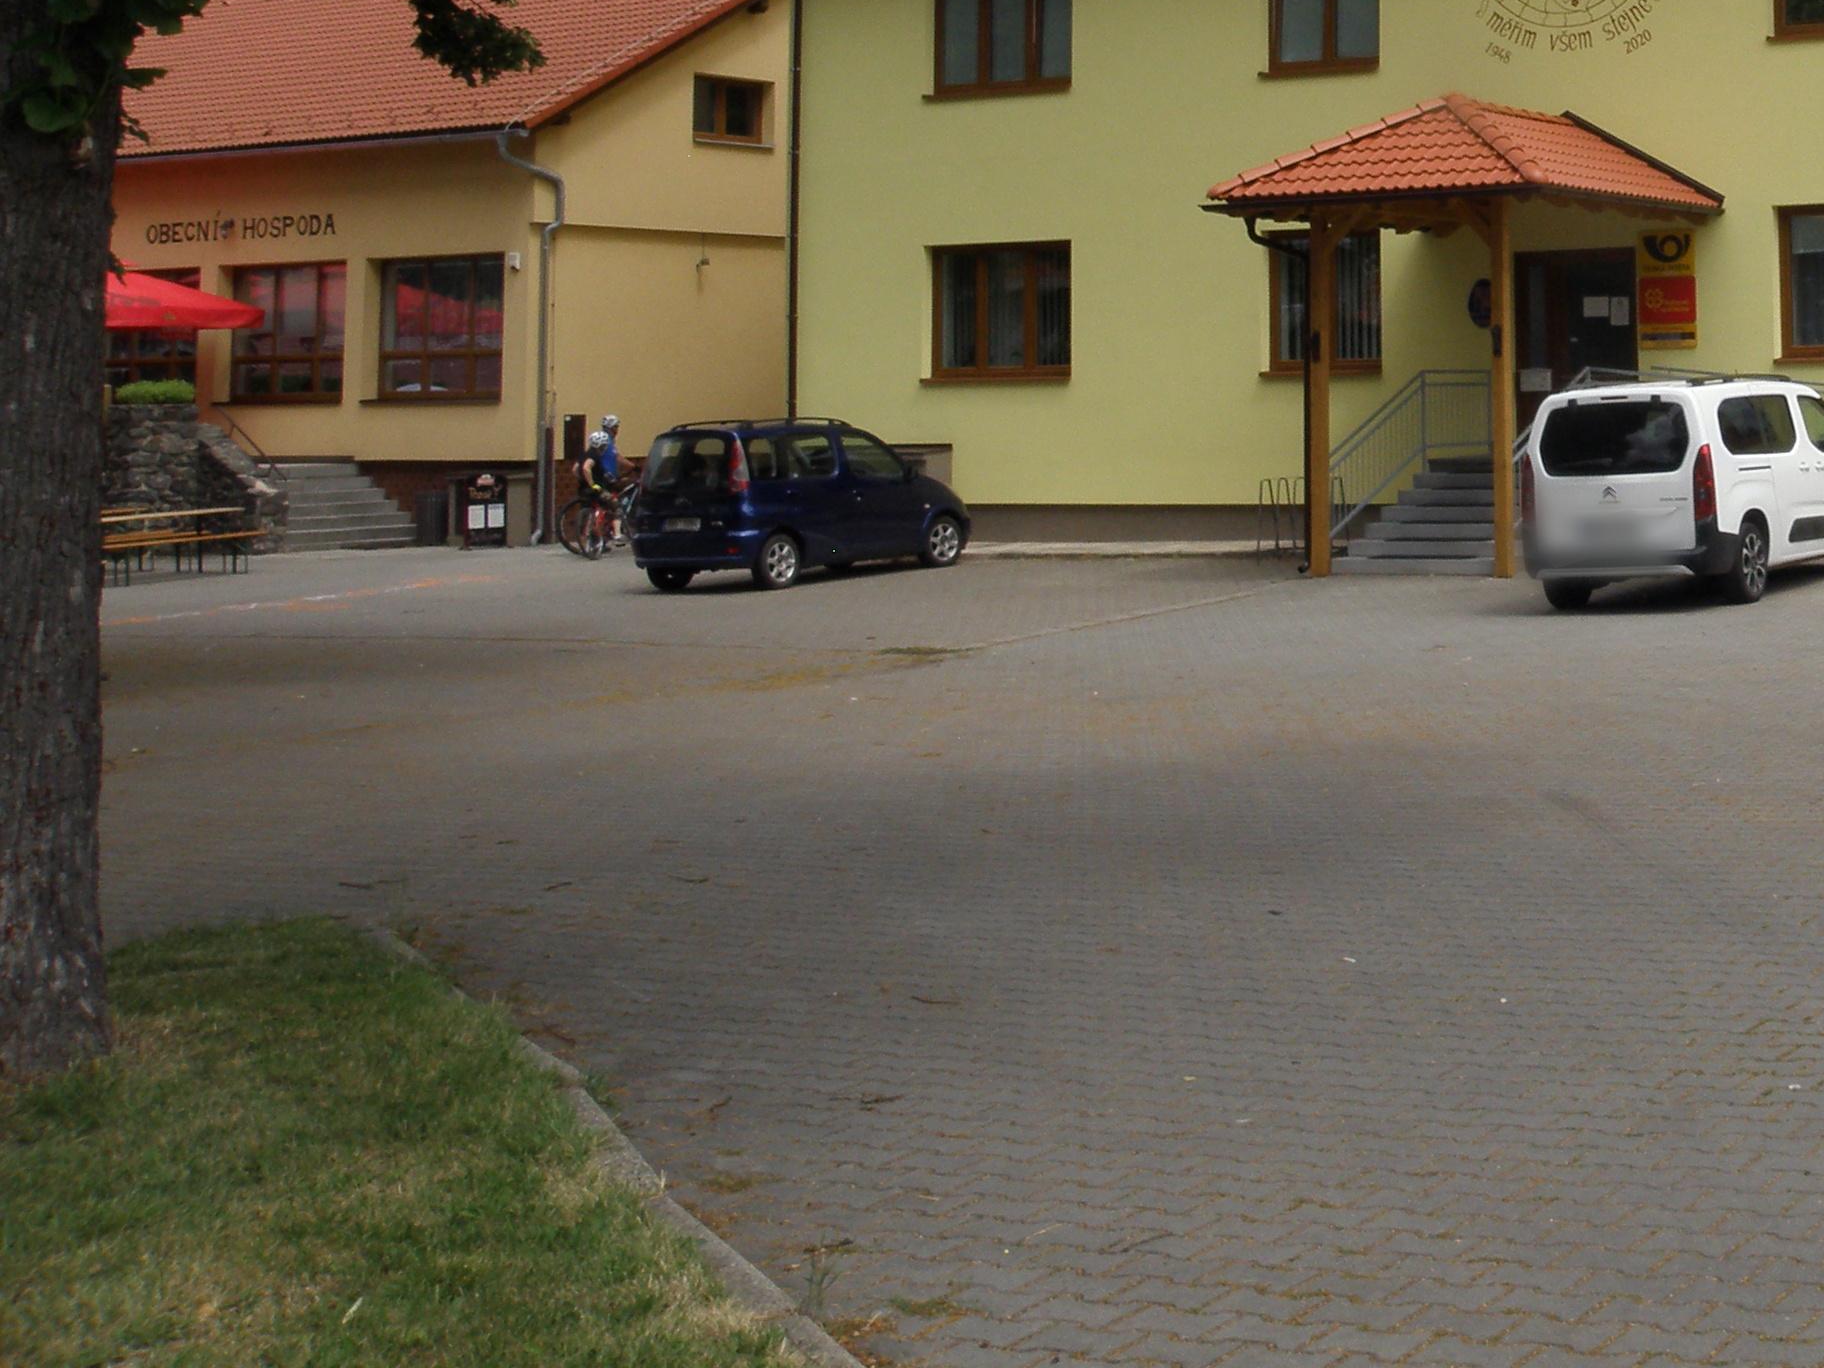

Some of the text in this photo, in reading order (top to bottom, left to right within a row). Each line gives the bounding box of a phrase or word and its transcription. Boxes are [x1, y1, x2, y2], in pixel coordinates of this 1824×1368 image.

[1549, 30, 1593, 52] všem
[1623, 29, 1652, 54] 2020
[1484, 42, 1513, 64] 1948
[146, 210, 336, 244] OBECNÍ HOSPODA
